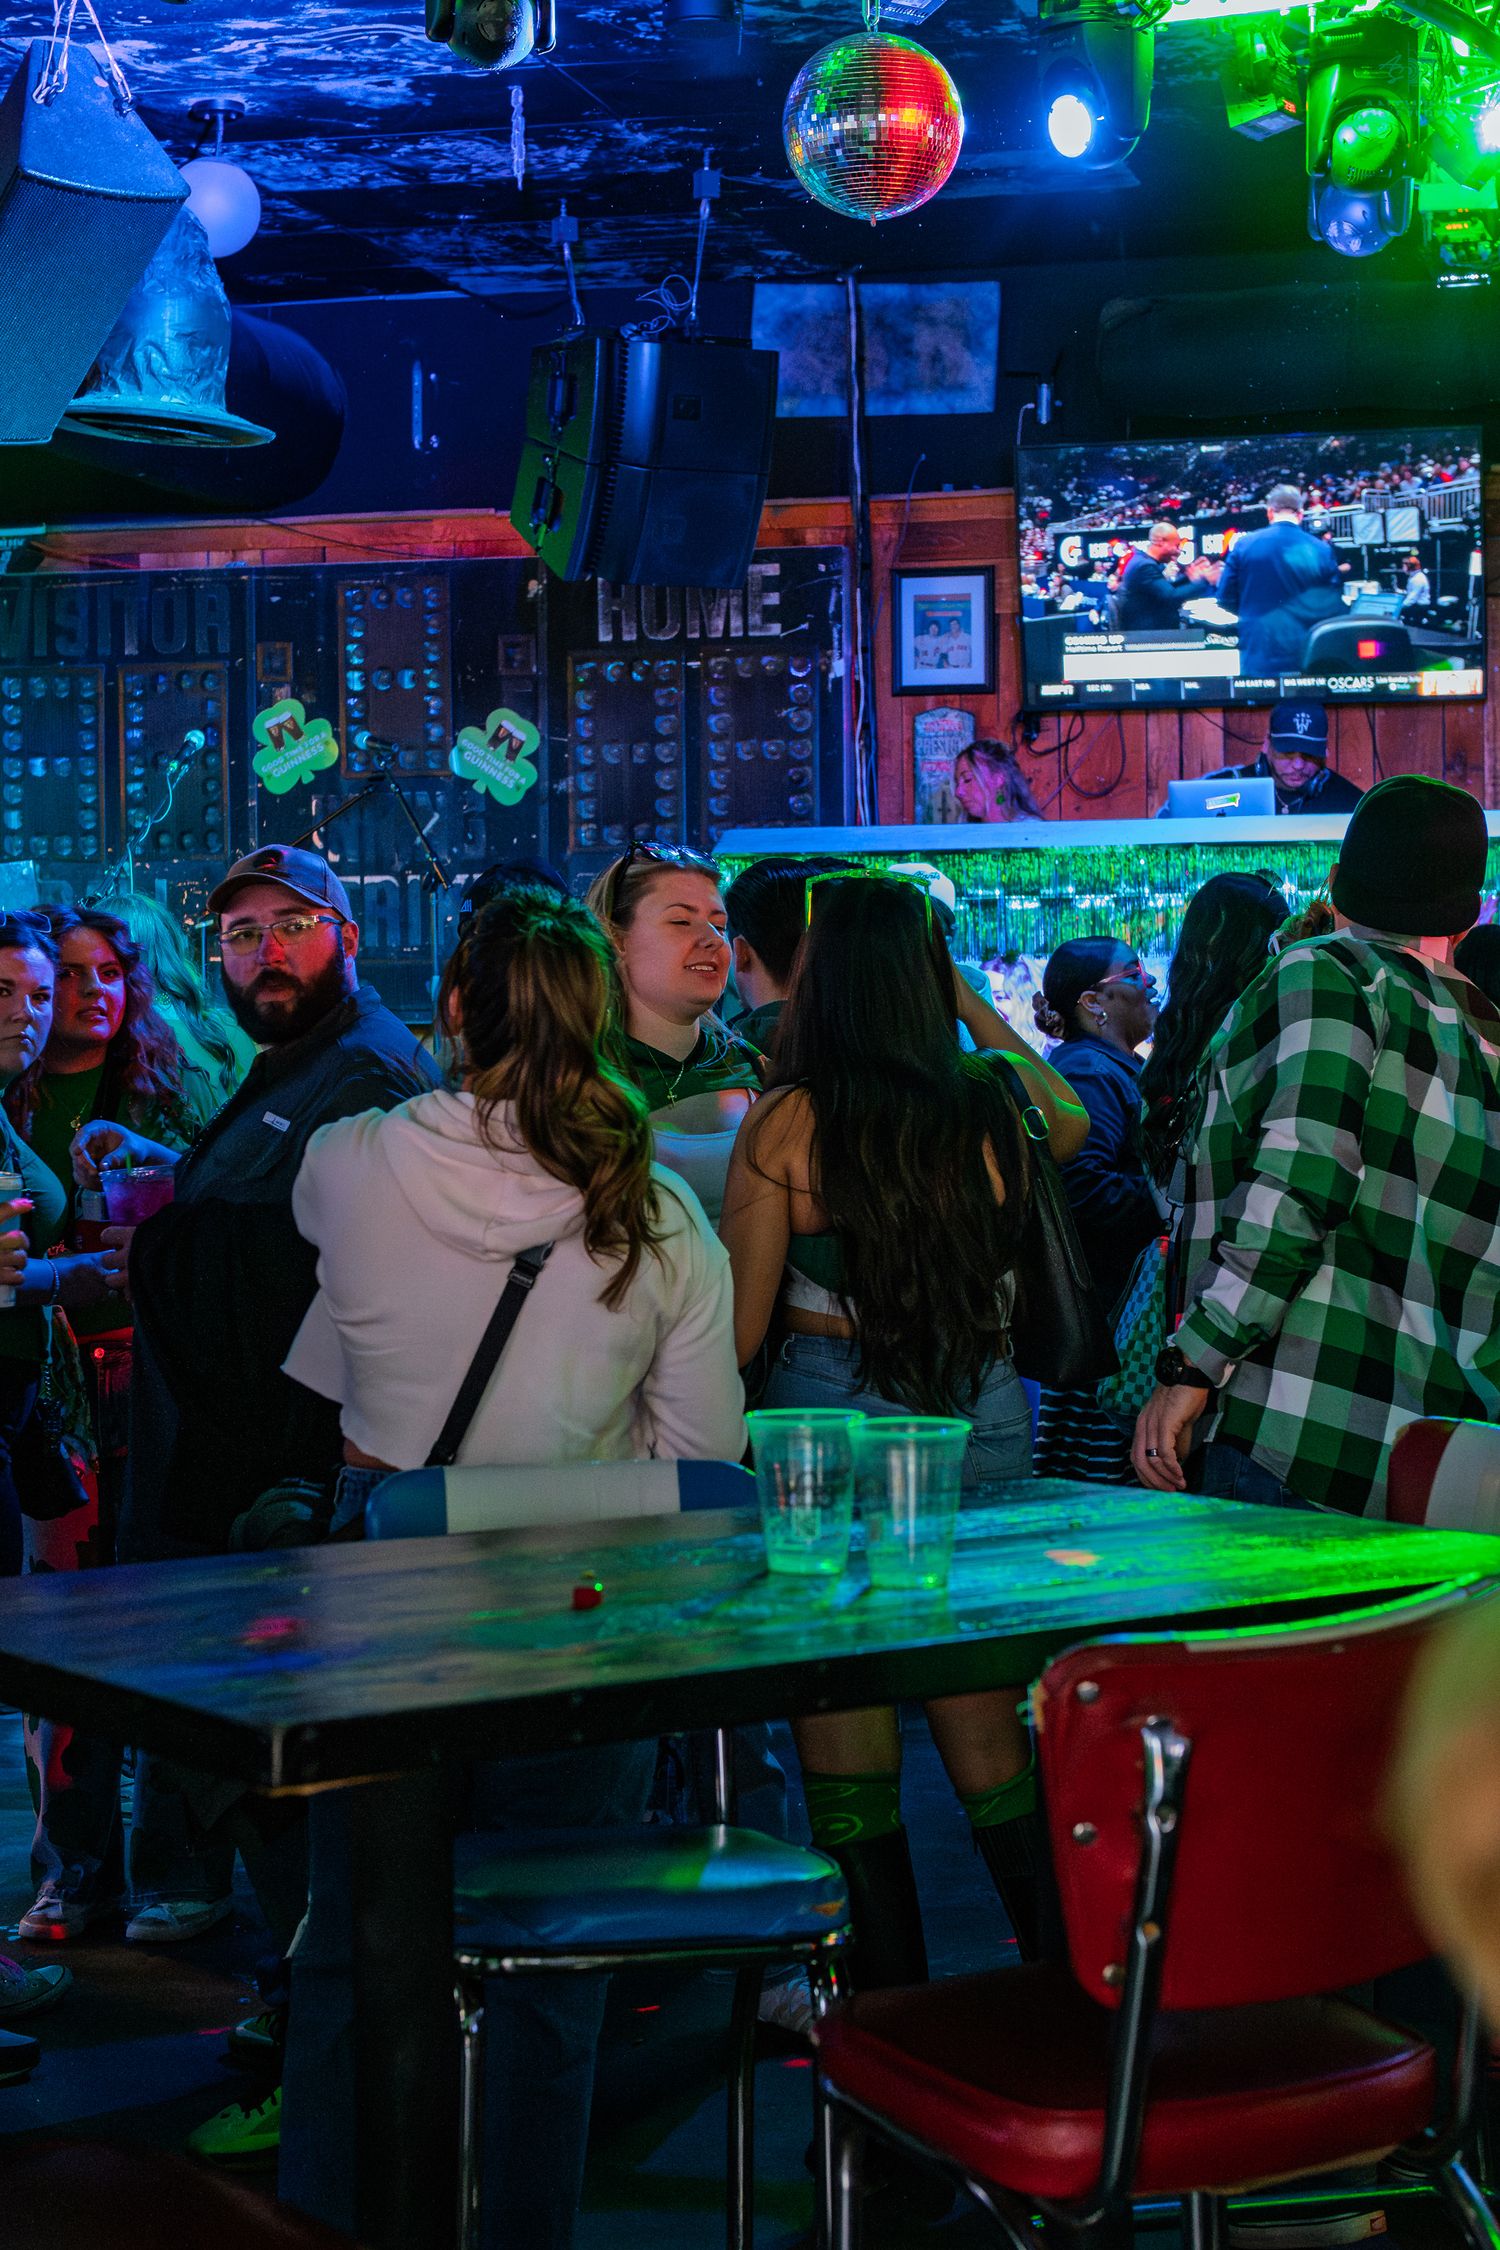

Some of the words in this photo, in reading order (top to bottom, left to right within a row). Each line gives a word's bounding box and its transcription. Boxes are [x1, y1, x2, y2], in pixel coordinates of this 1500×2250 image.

[0, 585, 231, 657] VISITOR
[598, 563, 782, 642] HOME
[1327, 676, 1375, 689] OSCARS
[273, 743, 324, 777] GUINNESS
[462, 739, 485, 756] GOOD
[486, 752, 505, 769] TIME
[504, 766, 520, 780] FOR
[464, 751, 514, 789] GUINNESS
